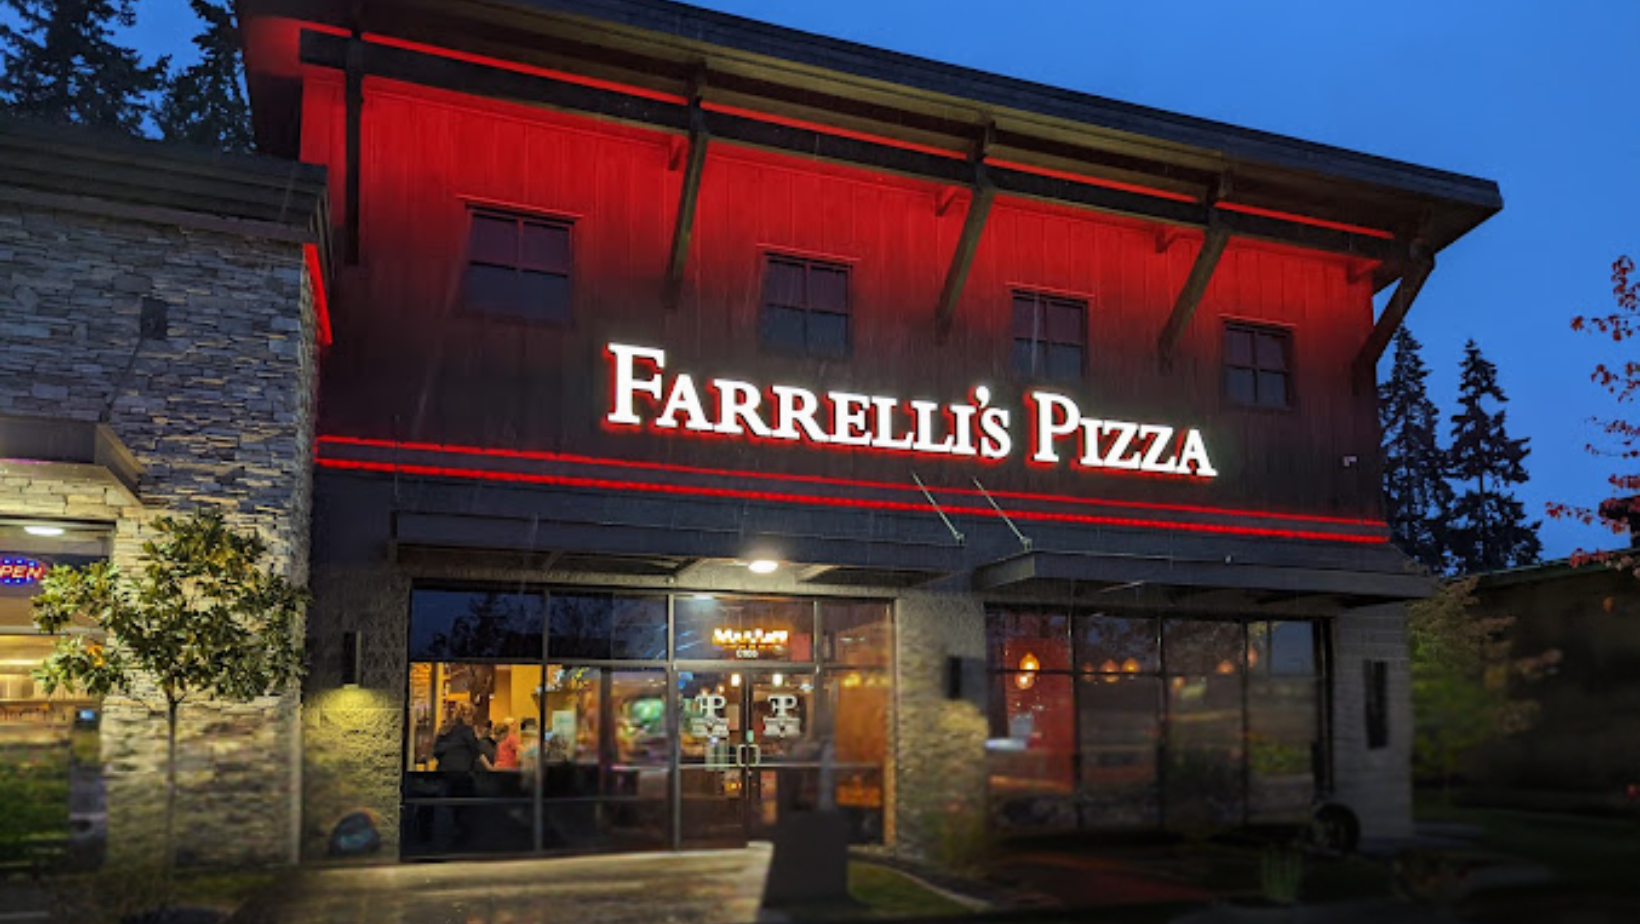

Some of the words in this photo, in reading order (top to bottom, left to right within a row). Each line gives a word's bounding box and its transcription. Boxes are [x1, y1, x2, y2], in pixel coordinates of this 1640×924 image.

[607, 342, 1011, 459] FARRELLI'S
[1031, 390, 1218, 477] PIZZA
[0, 564, 43, 581] PEN
